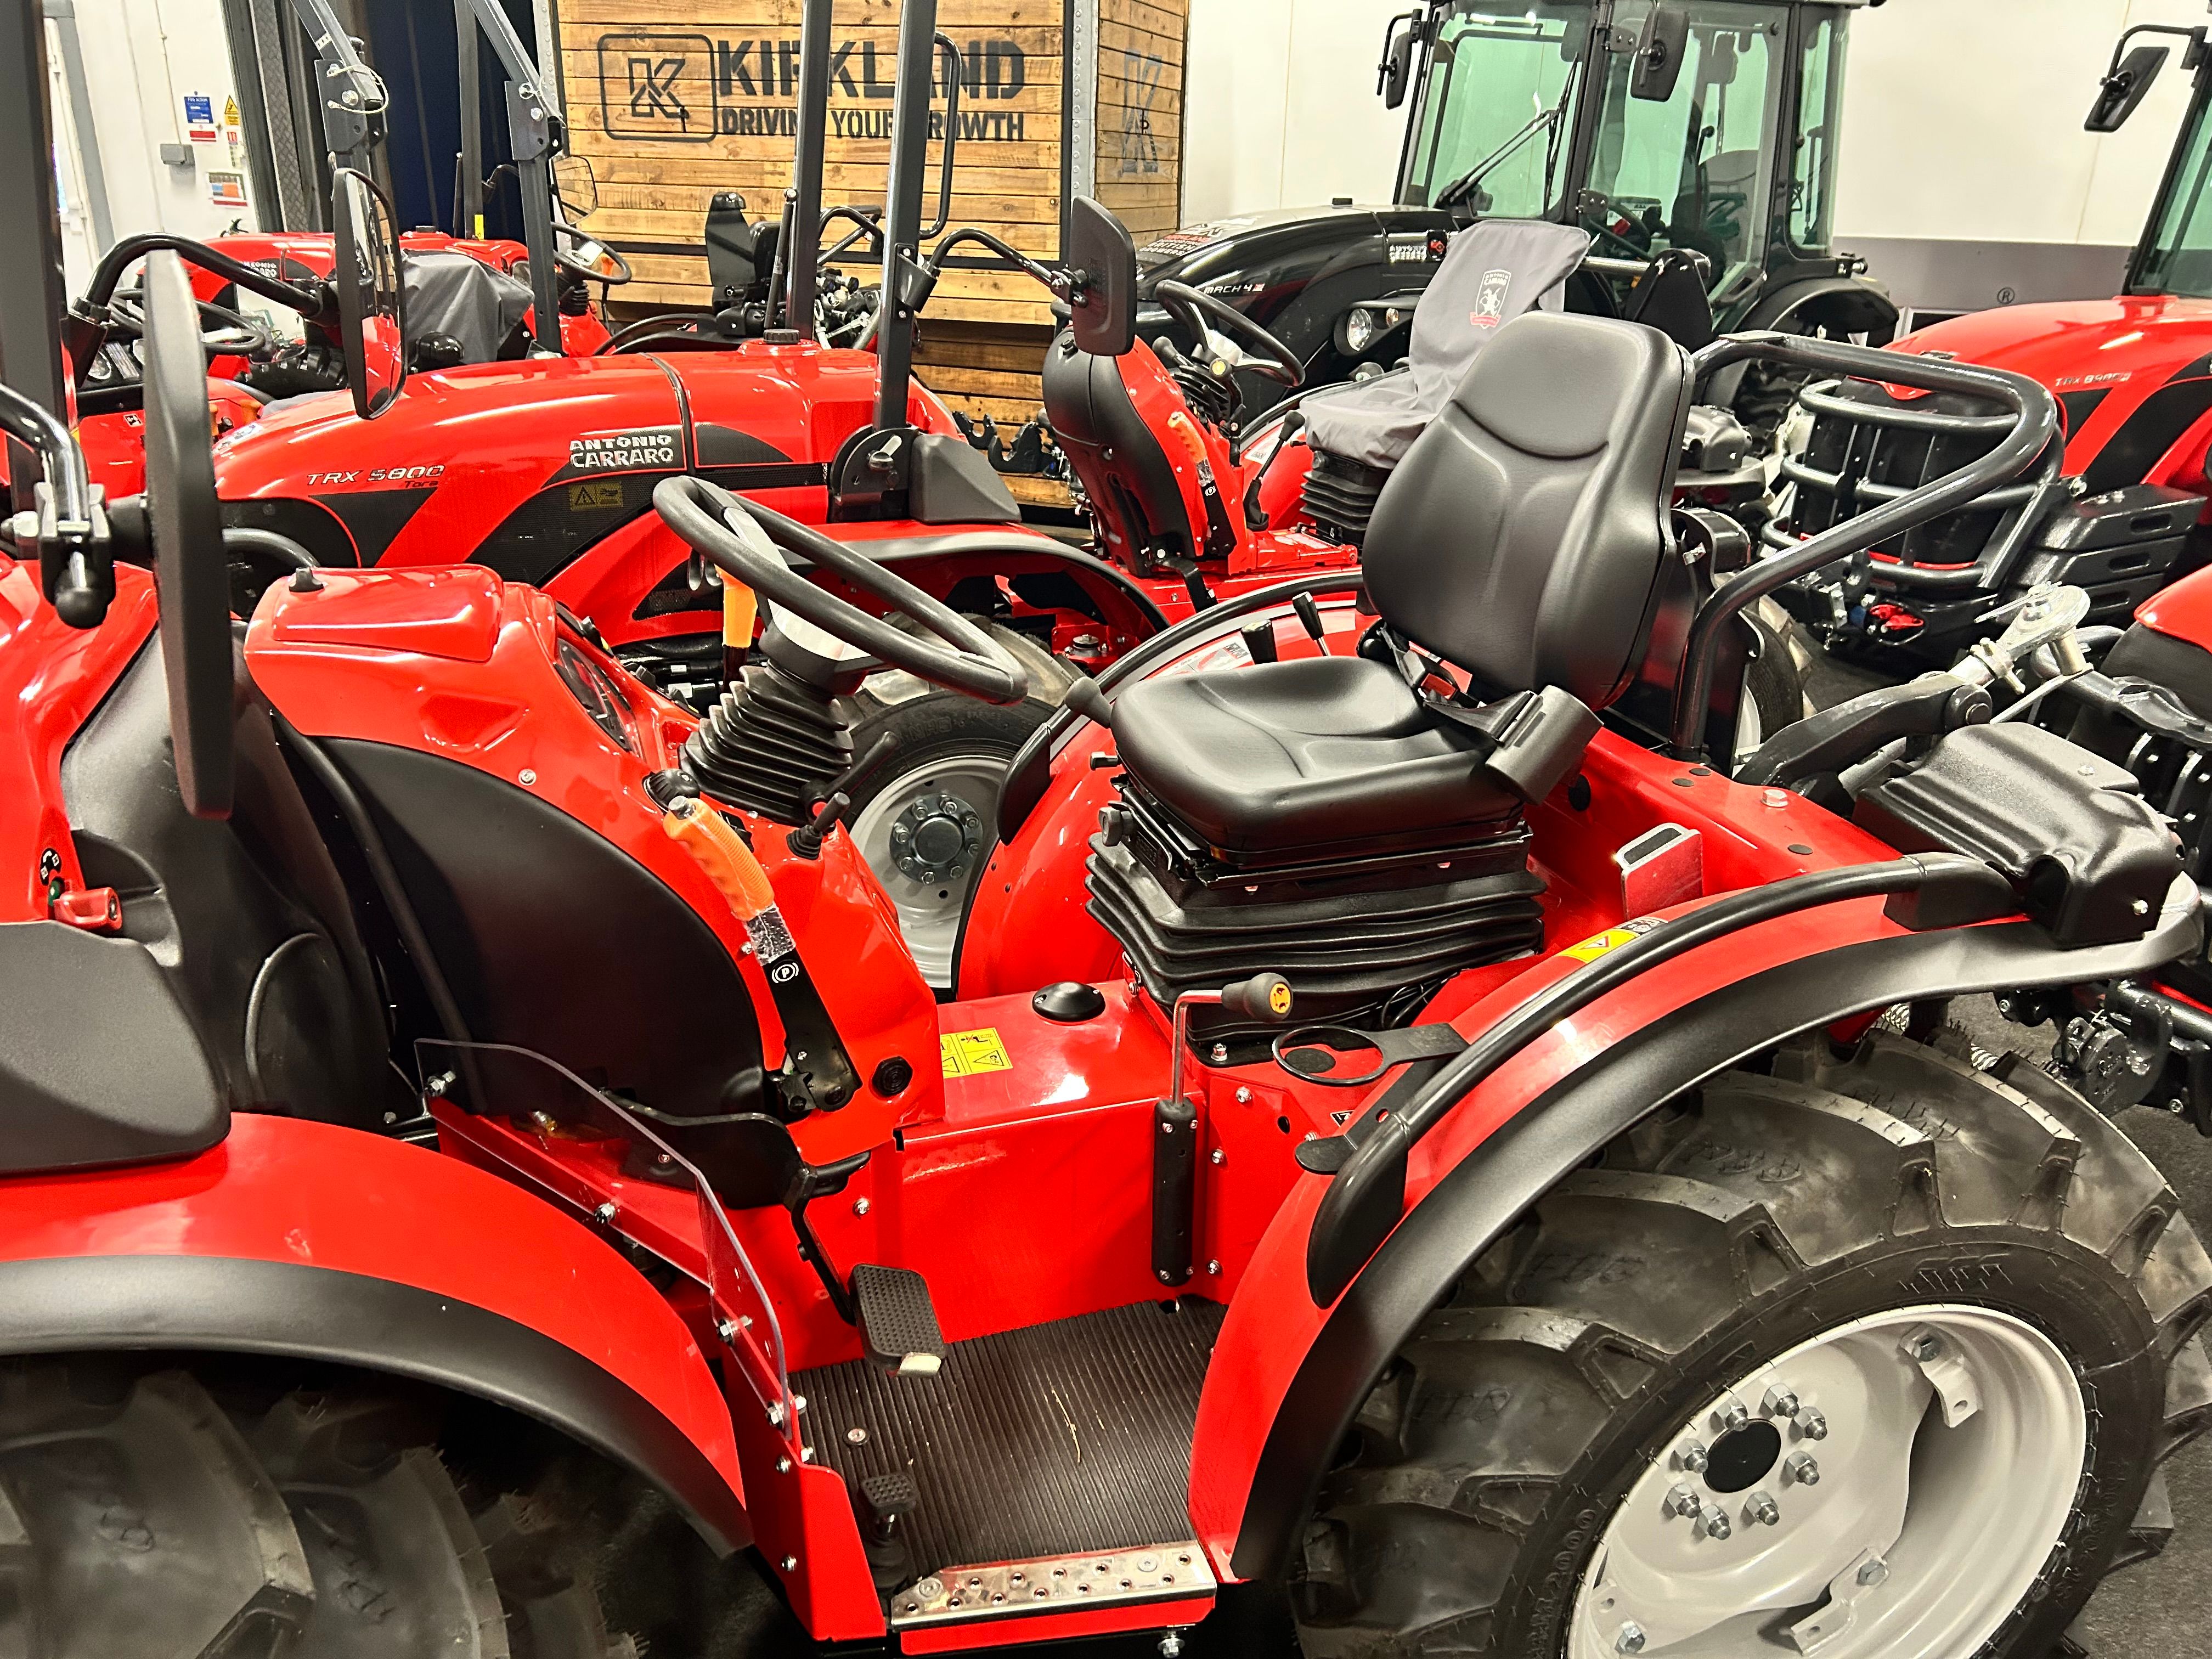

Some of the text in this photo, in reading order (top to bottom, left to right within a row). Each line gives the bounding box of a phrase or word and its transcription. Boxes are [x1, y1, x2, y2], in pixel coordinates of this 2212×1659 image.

[1204, 285, 1242, 294] MACH
[569, 435, 672, 451] ANTONIO
[570, 447, 674, 468] CARRARO
[307, 465, 445, 486] TRX 5800
